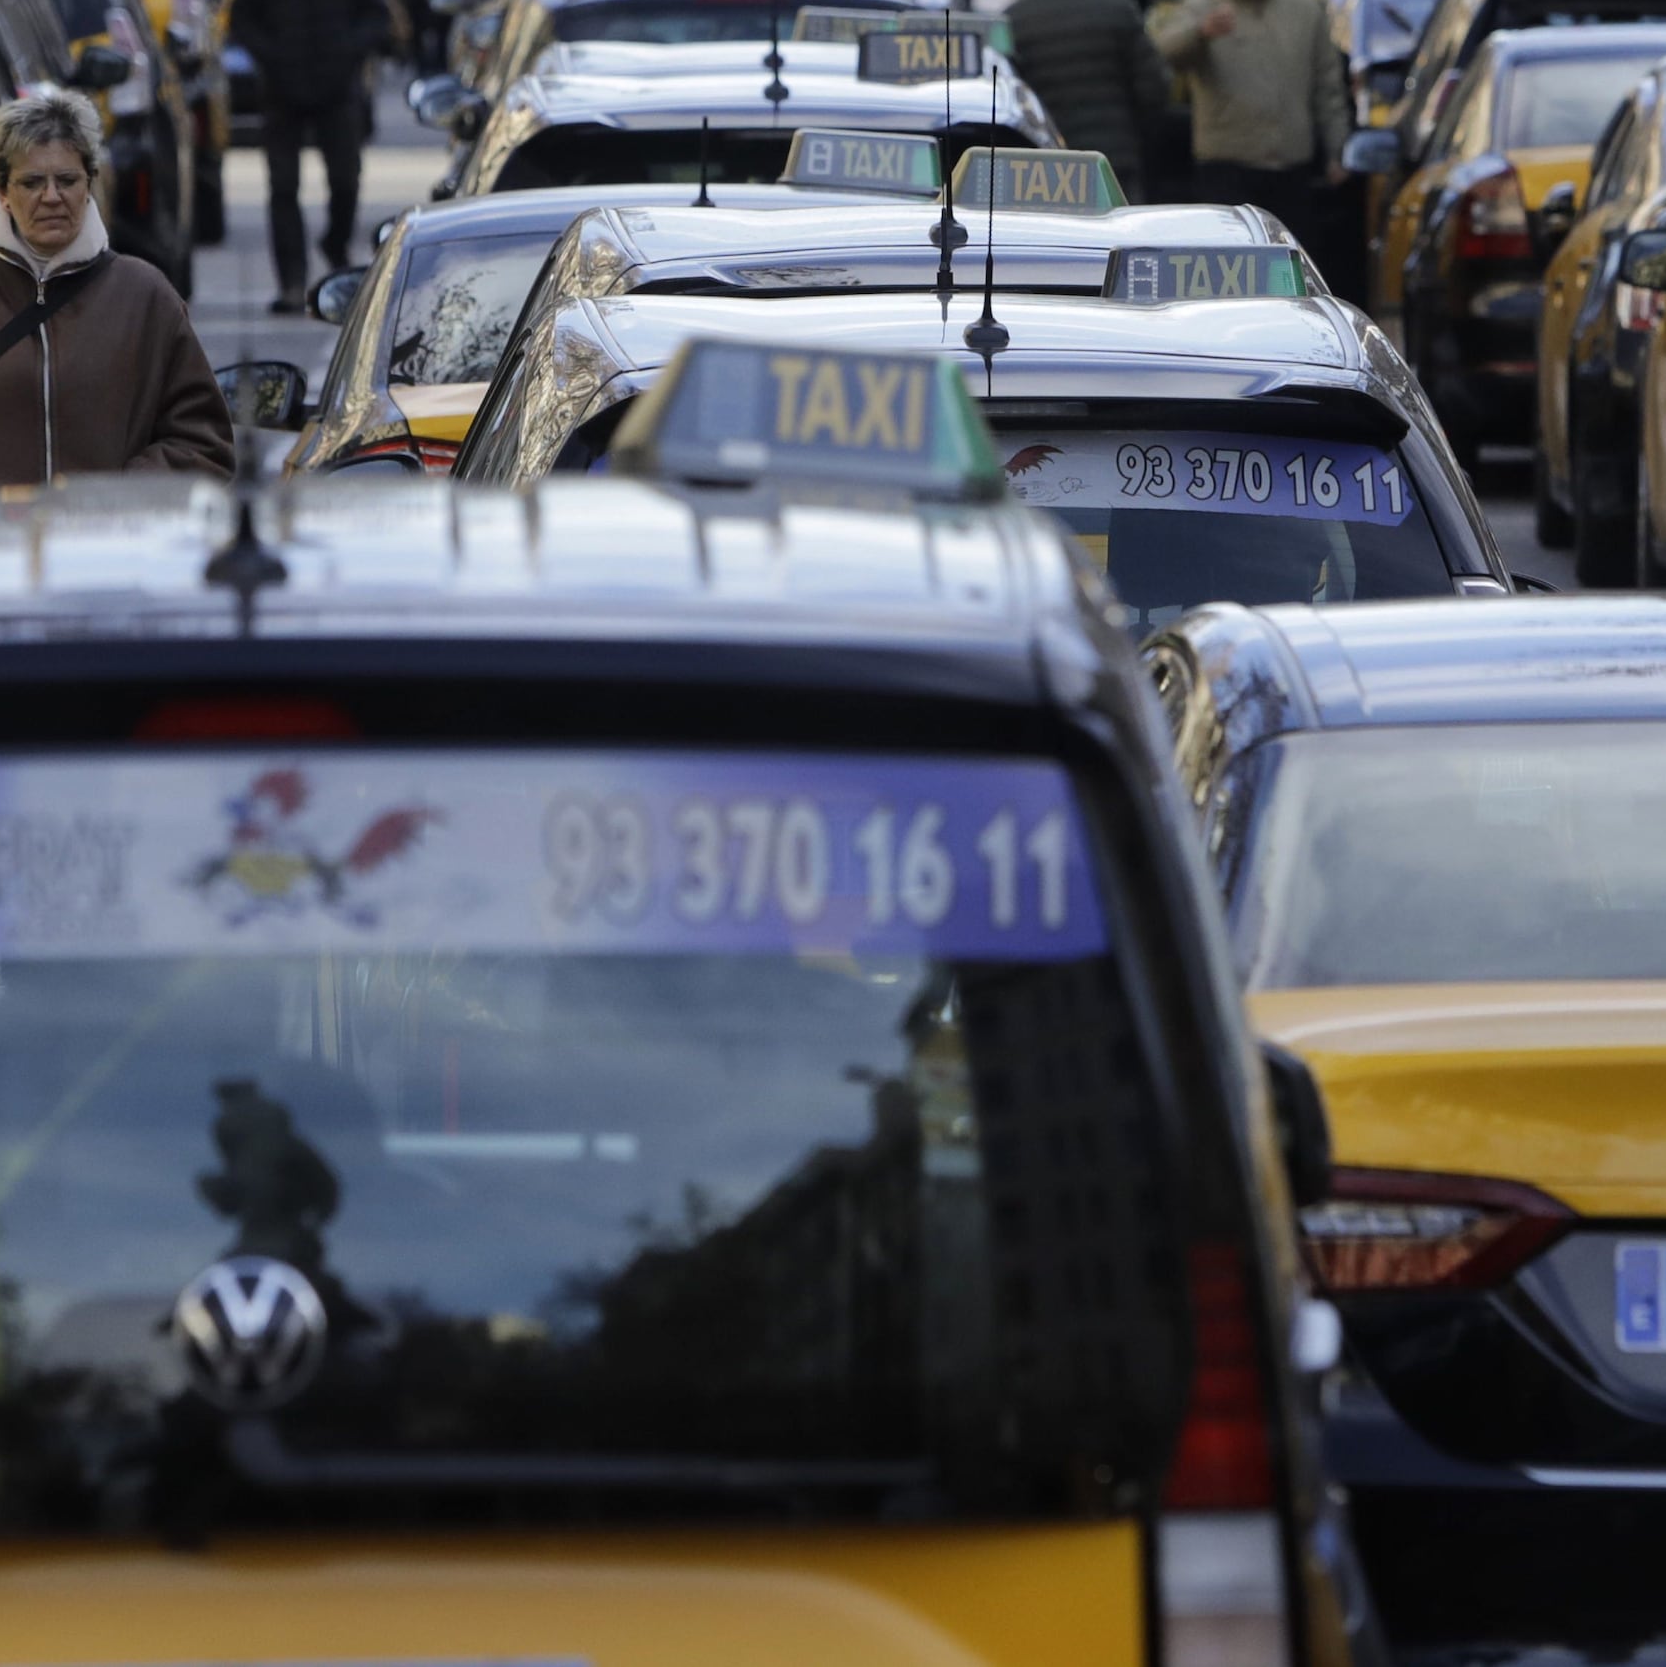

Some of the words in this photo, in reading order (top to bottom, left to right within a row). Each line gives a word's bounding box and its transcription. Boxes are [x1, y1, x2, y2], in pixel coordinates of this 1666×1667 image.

[895, 36, 960, 69] TAXI
[841, 140, 905, 180] TAXI
[1010, 160, 1087, 203] TAXI
[1169, 254, 1256, 297] TAXI
[772, 354, 926, 452] TAXI
[1116, 443, 1176, 499] 93
[1185, 447, 1272, 503] 370
[1285, 452, 1341, 509] 16
[1353, 457, 1404, 515] 11
[542, 788, 653, 930] 93
[673, 795, 828, 927] 370
[853, 798, 955, 929] 16
[977, 806, 1068, 930] 11
